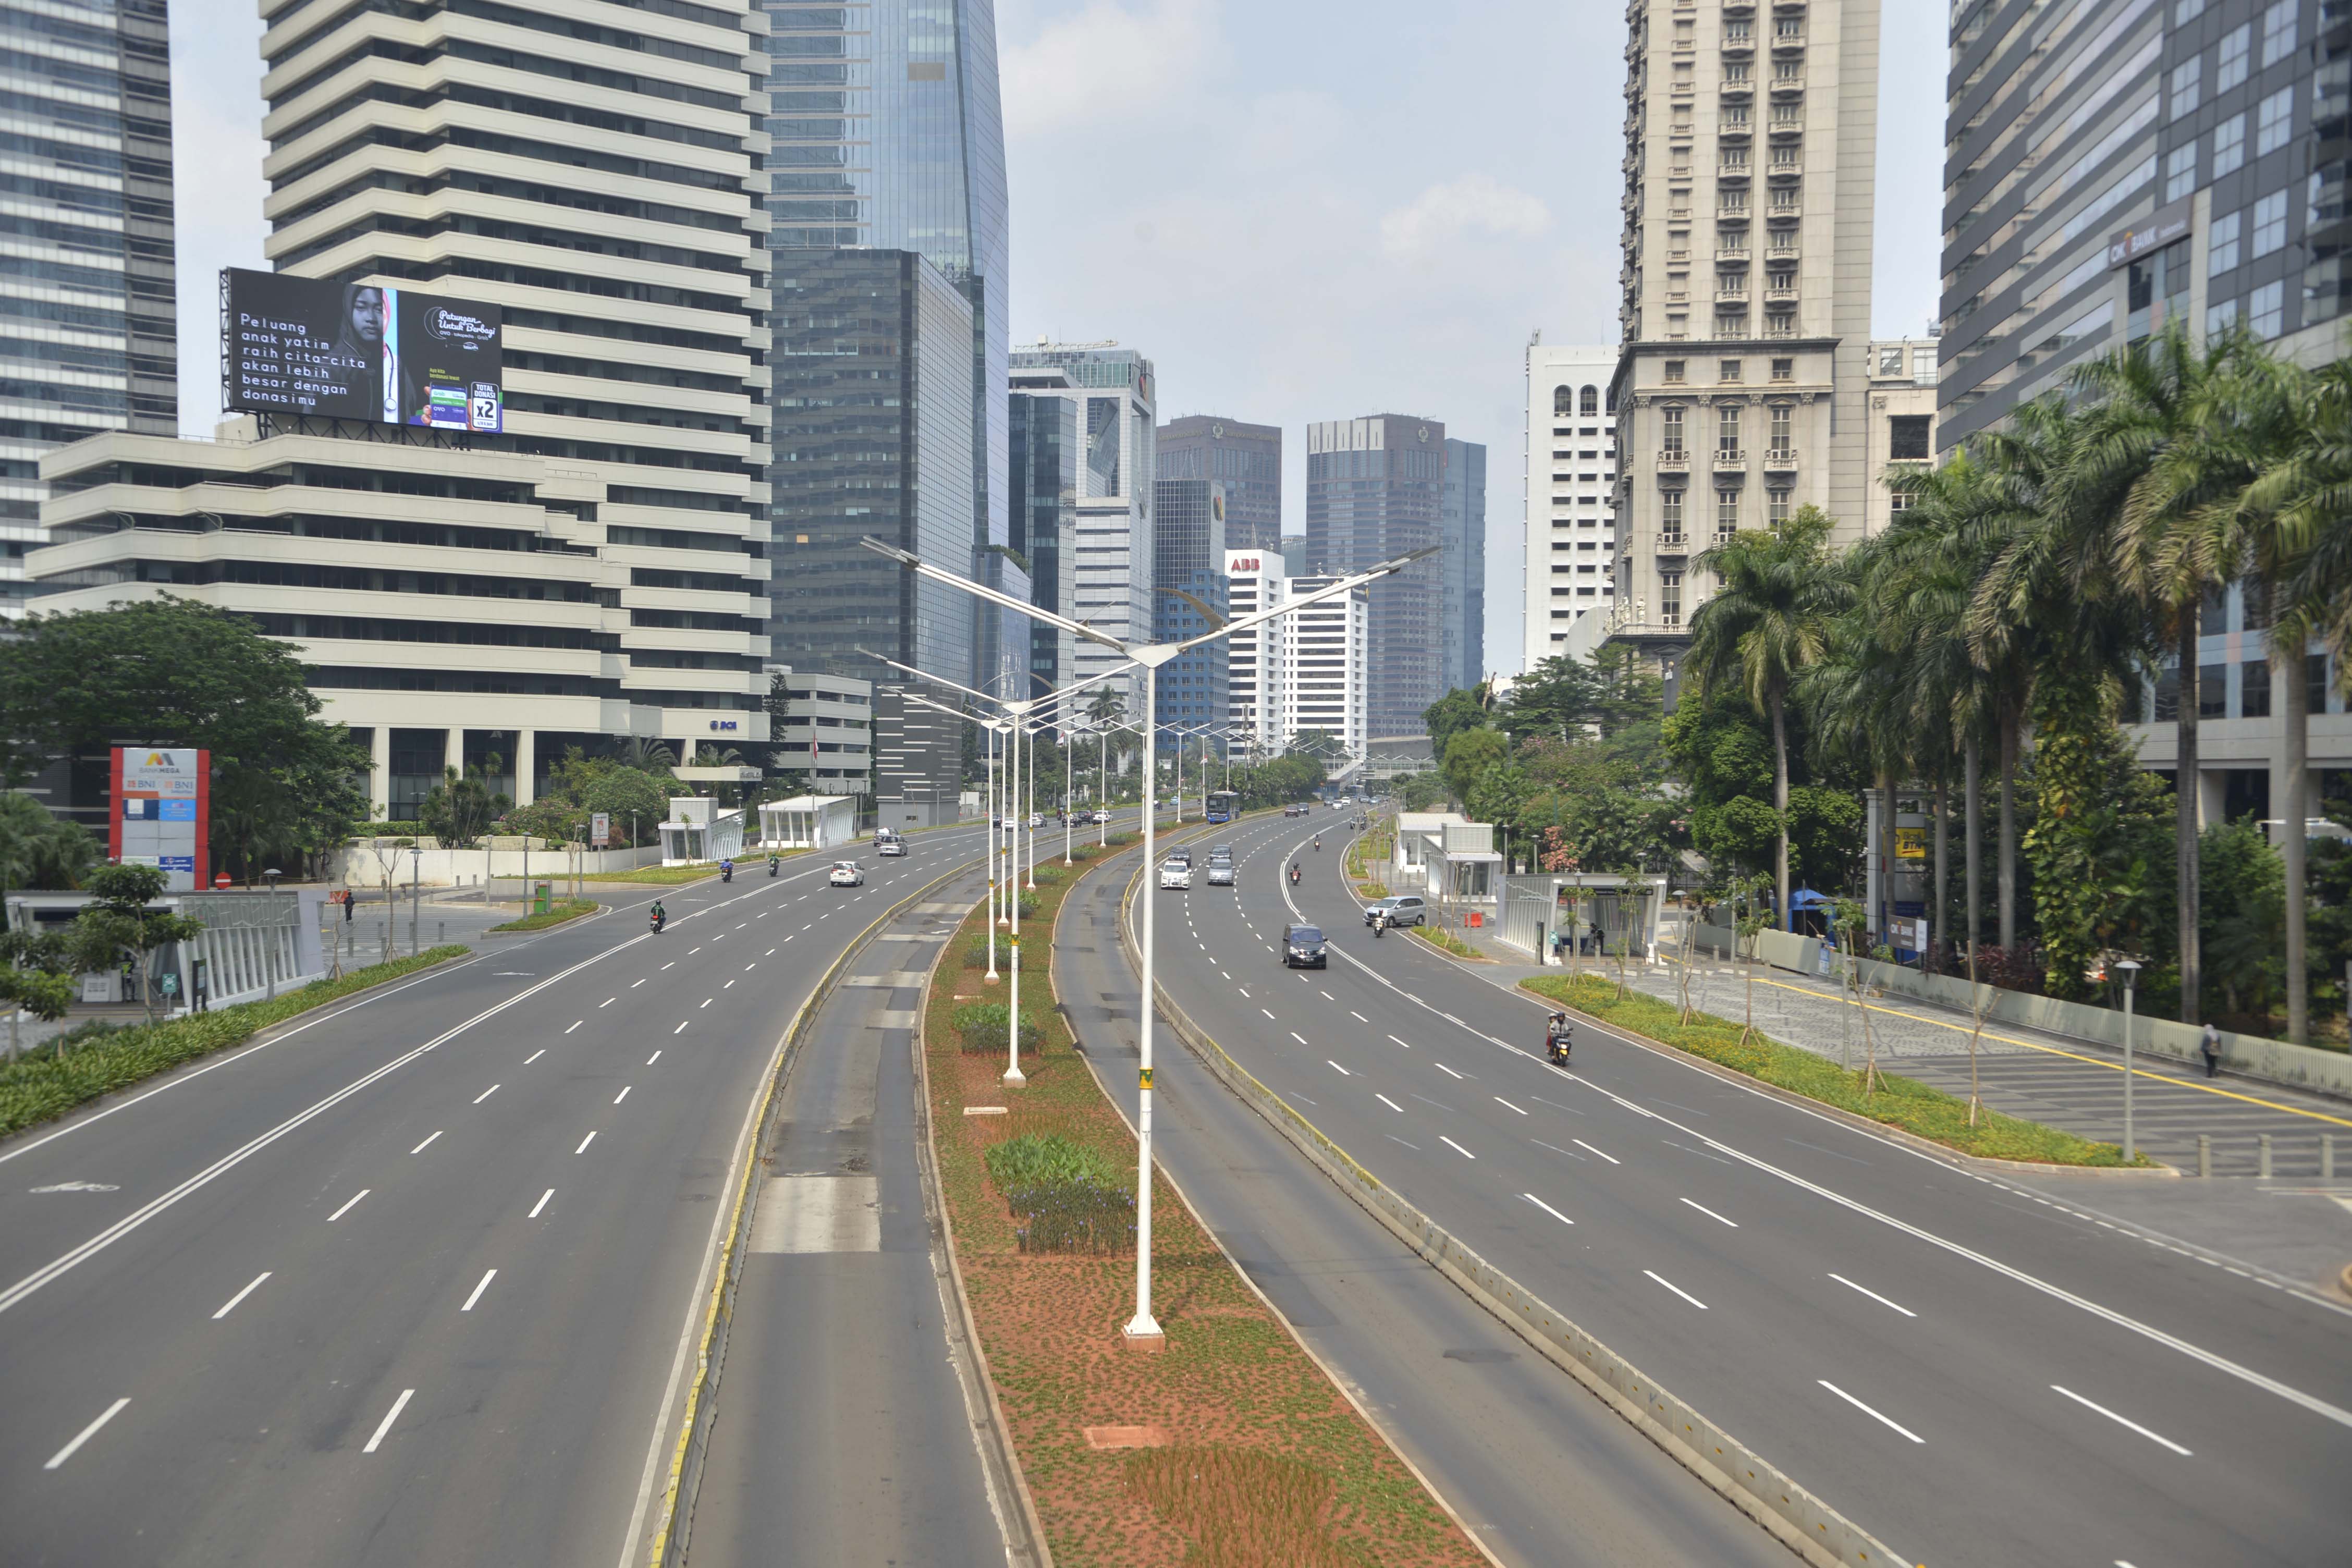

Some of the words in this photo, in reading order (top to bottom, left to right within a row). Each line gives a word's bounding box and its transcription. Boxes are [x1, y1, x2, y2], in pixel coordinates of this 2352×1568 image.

[240, 313, 306, 335] Peluang
[439, 310, 482, 325] Patungan
[438, 319, 464, 331] Untuk
[467, 323, 496, 338] Berbagi
[241, 332, 279, 344] anak
[284, 337, 329, 350] yatim
[243, 347, 279, 359] raih
[285, 351, 366, 369] cita-cita
[242, 360, 279, 373] akan
[287, 364, 329, 379] lebih
[242, 373, 288, 388] besar
[293, 379, 348, 395] dengan
[476, 384, 494, 392] TOTAL
[242, 389, 316, 406] donasimu
[474, 390, 496, 398] DONASI
[1231, 558, 1260, 571] ABB
